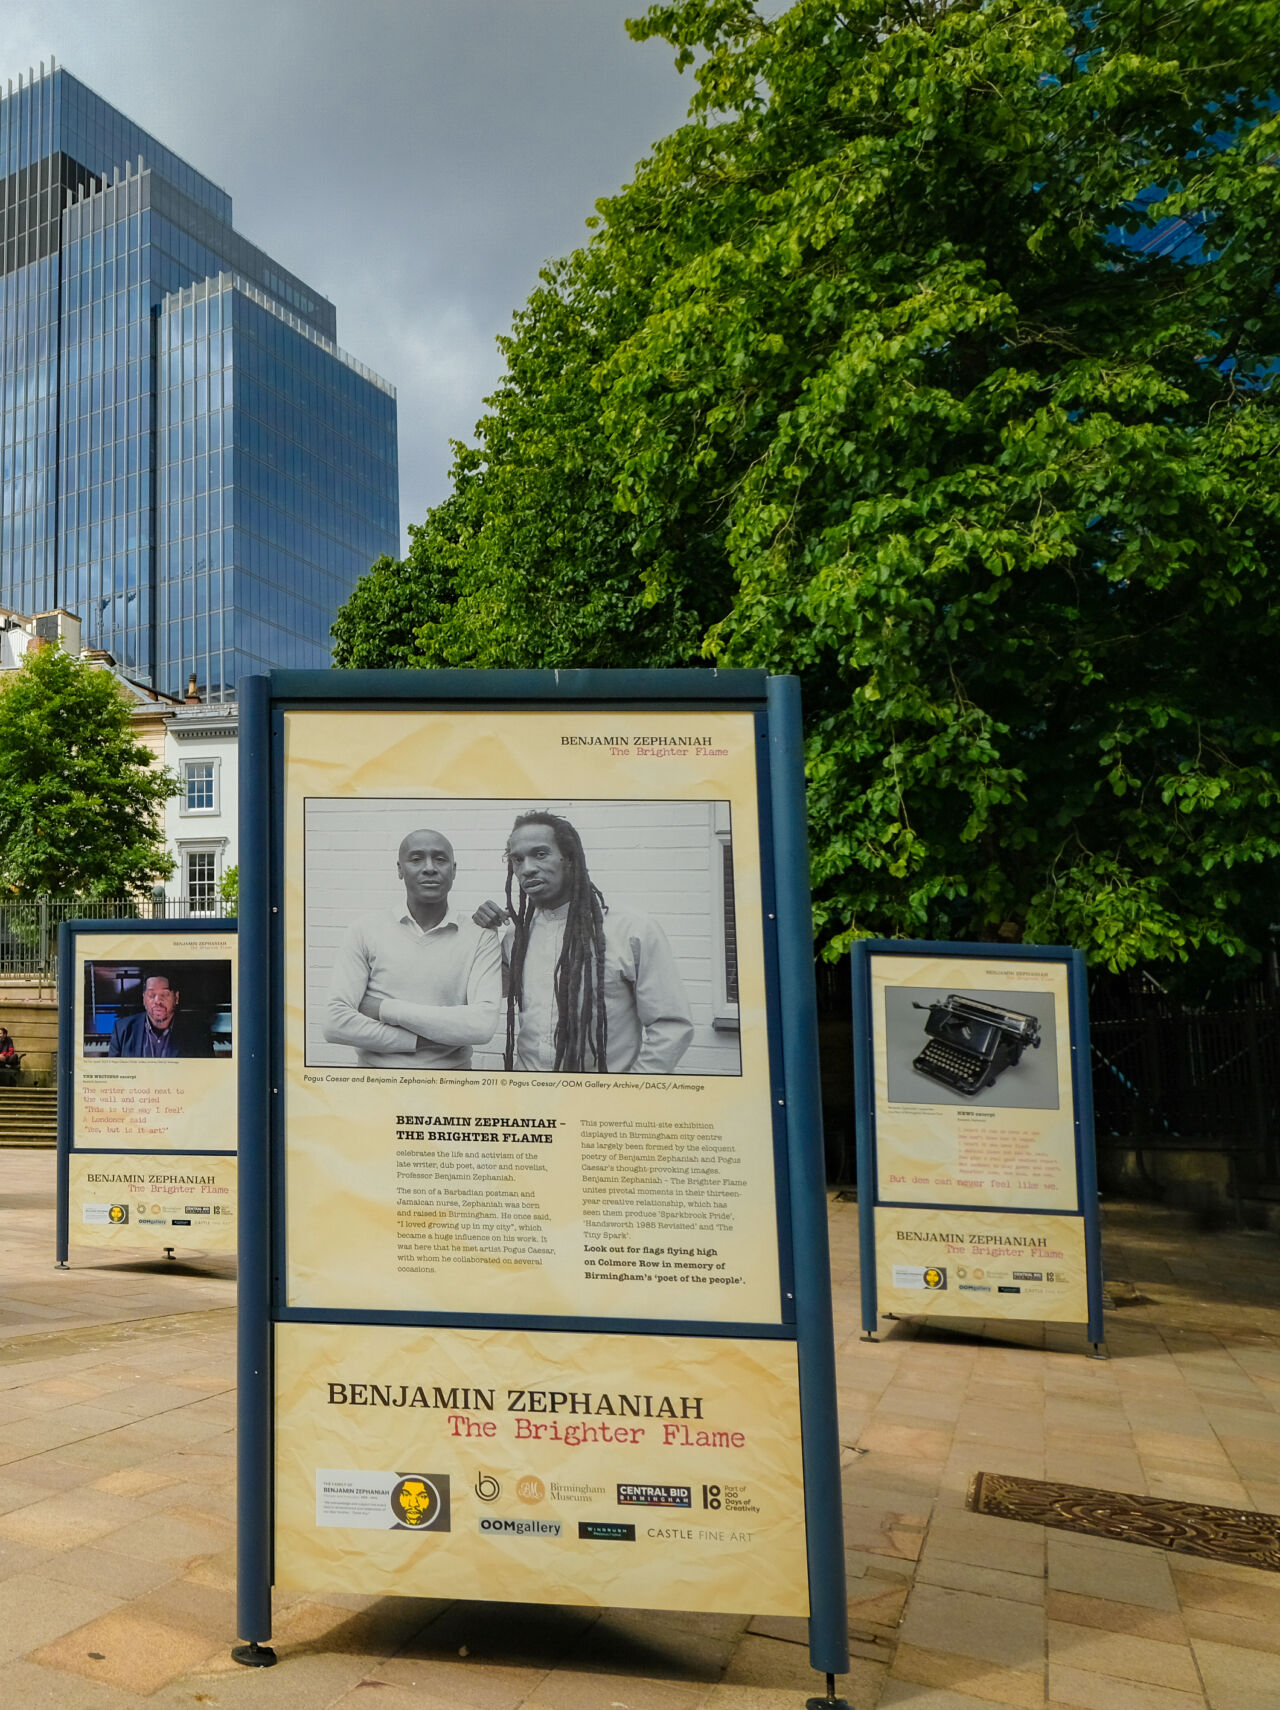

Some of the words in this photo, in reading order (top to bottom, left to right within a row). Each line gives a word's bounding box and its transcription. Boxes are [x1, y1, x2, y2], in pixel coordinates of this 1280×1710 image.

[561, 736, 629, 746] BENJAMIN
[633, 736, 712, 746] ZEPHANIAH
[610, 747, 630, 757] The
[636, 747, 689, 758] Brighter
[695, 747, 729, 757] Flame
[396, 1115, 472, 1127] BENJAMIN
[475, 1117, 557, 1129] ZEPHANIAH
[580, 1119, 598, 1127] This
[599, 1119, 634, 1130] powerful
[635, 1120, 673, 1129] multi-site
[674, 1121, 714, 1130] exhibition
[396, 1131, 425, 1140] THE
[428, 1131, 499, 1142] BRIGHTER
[502, 1133, 553, 1143] FLAME
[580, 1130, 618, 1141] displayed
[629, 1132, 679, 1143] Birmingham
[680, 1133, 695, 1143] city
[696, 1133, 722, 1142] centre
[396, 1148, 436, 1157] celebrates
[437, 1149, 450, 1158] the
[451, 1150, 464, 1158] life
[465, 1150, 480, 1158] and
[481, 1150, 515, 1159] activism
[525, 1151, 538, 1160] the
[396, 1160, 412, 1168] late
[412, 1160, 439, 1170] writer,
[439, 1161, 455, 1169] dub
[456, 1161, 475, 1172] poet,
[476, 1162, 498, 1170] actor
[498, 1162, 514, 1171] and
[515, 1163, 548, 1173] novelist,
[87, 1173, 145, 1183] BENJAMIN
[148, 1175, 216, 1185] ZEPHANIAH
[397, 1171, 433, 1180] Professor
[434, 1172, 471, 1183] Benjamin
[472, 1173, 516, 1184] Zephaniah.
[127, 1184, 145, 1193] The
[150, 1184, 196, 1195] Brighter
[200, 1185, 229, 1194] Flame
[896, 1230, 965, 1244] BENJAMIN
[968, 1234, 1047, 1248] ZEPHANIAH
[627, 1246, 641, 1254] for
[643, 1247, 665, 1256] flags
[667, 1247, 695, 1257] flying
[696, 1248, 718, 1258] high
[945, 1244, 966, 1255] The
[971, 1245, 1024, 1258] Brighter
[1030, 1248, 1064, 1260] Flame
[598, 1259, 637, 1267] Colmore
[639, 1260, 660, 1268] Row
[662, 1260, 672, 1268] in
[674, 1263, 714, 1271] memory
[716, 1262, 726, 1270] of
[585, 1272, 652, 1282] Birmingham's
[654, 1274, 678, 1283] 'poet
[691, 1275, 707, 1283] the
[709, 1276, 746, 1286] people'.
[327, 1382, 495, 1412] BENJAMIN
[507, 1389, 705, 1420] ZEPHANIAH
[447, 1414, 497, 1438] The
[514, 1418, 646, 1446] Brighter
[662, 1423, 747, 1449] Flame
[550, 1481, 606, 1495] Birmingham
[620, 1486, 667, 1497] CENTRAL
[669, 1488, 688, 1498] BID
[725, 1485, 739, 1493] Part
[740, 1485, 747, 1493] of
[550, 1491, 593, 1504] Museums
[620, 1495, 690, 1504] BIRMINGHAM
[725, 1498, 740, 1507] Days
[725, 1505, 761, 1514] Creativity
[480, 1519, 562, 1536] OOMgallery
[647, 1528, 694, 1541] CASTLE
[698, 1530, 726, 1542] FINE
[730, 1531, 755, 1543] ART
